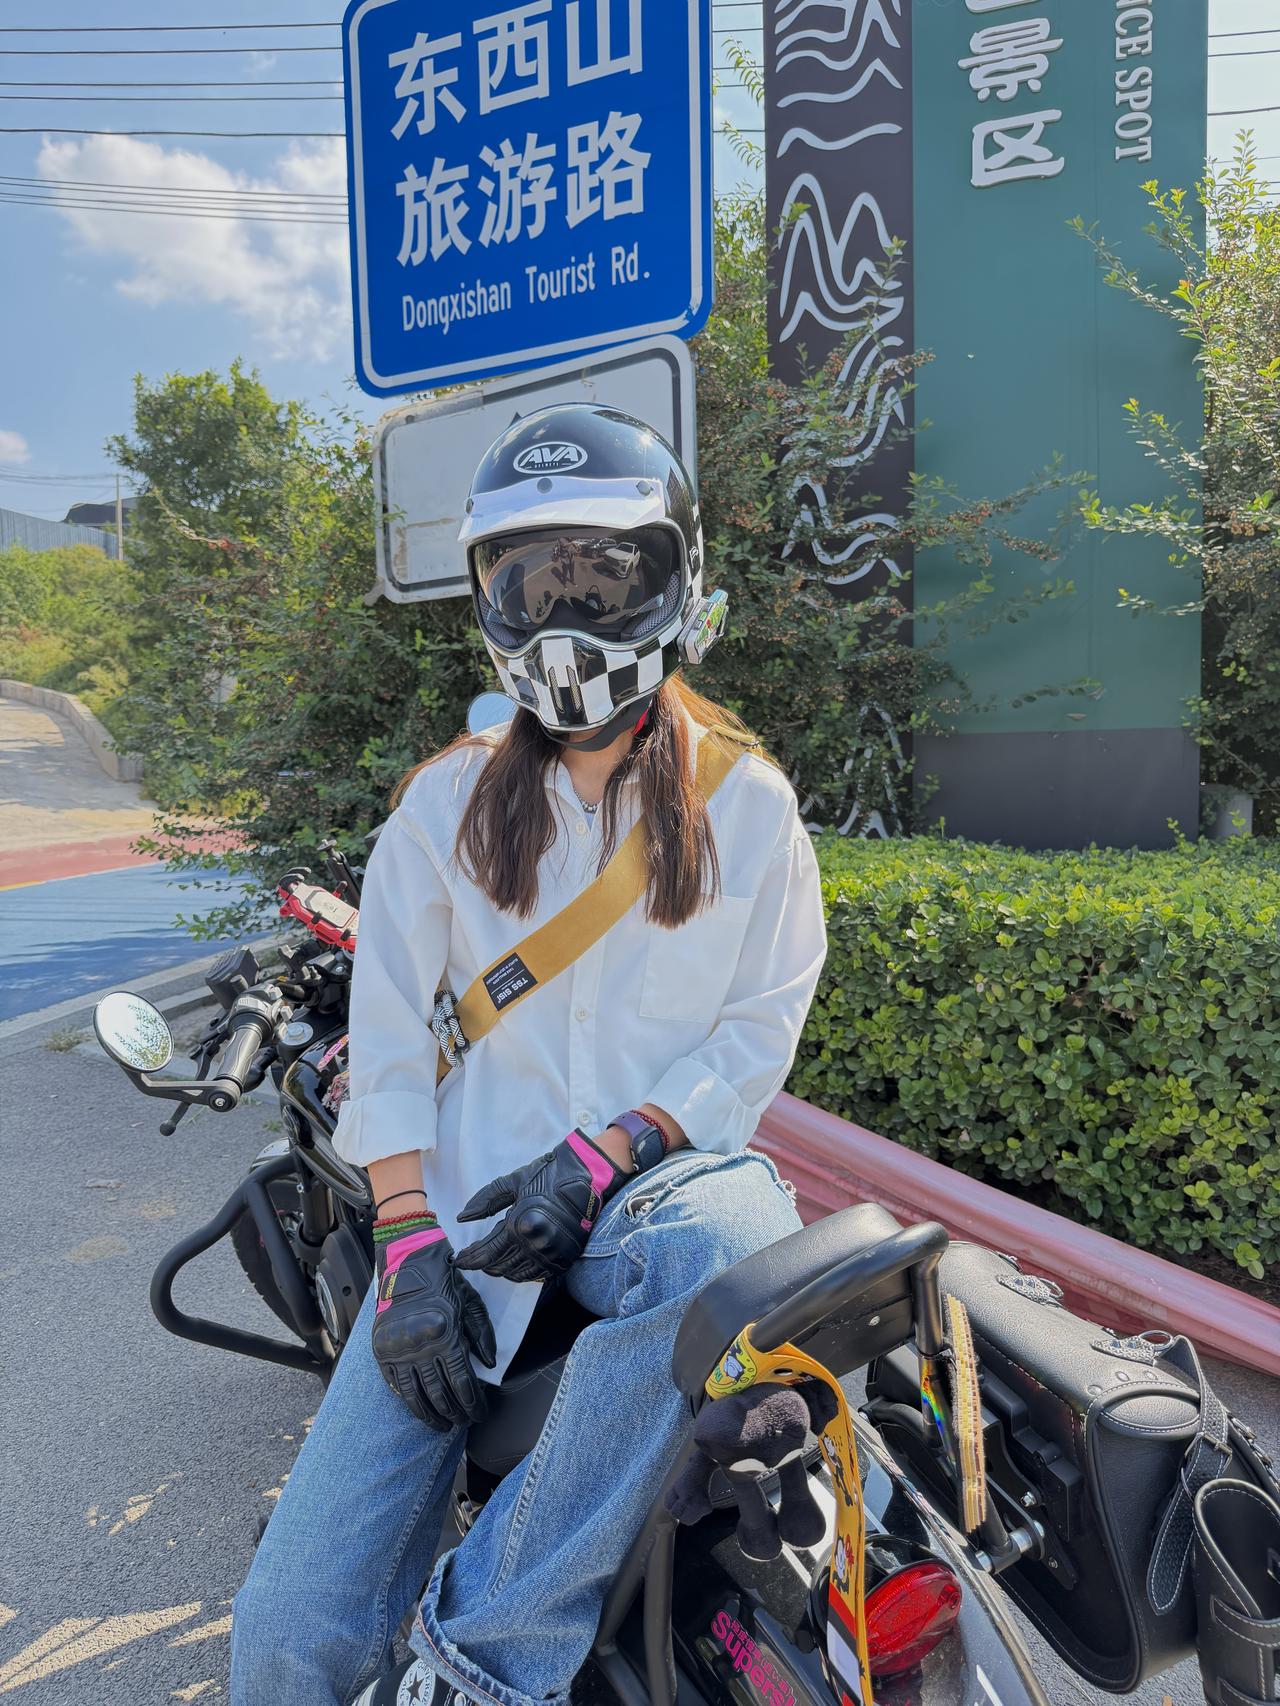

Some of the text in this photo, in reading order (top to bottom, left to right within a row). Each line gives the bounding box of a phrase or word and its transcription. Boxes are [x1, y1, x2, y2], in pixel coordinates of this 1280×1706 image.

[388, 0, 644, 141] 东西山
[957, 0, 1065, 189] 景区
[1115, 67, 1153, 162] SPOT
[395, 111, 651, 268] 旅游路
[402, 241, 650, 335] Dongxishan Tourist Rd.
[519, 446, 579, 467] AVA
[513, 977, 529, 992] TSS
